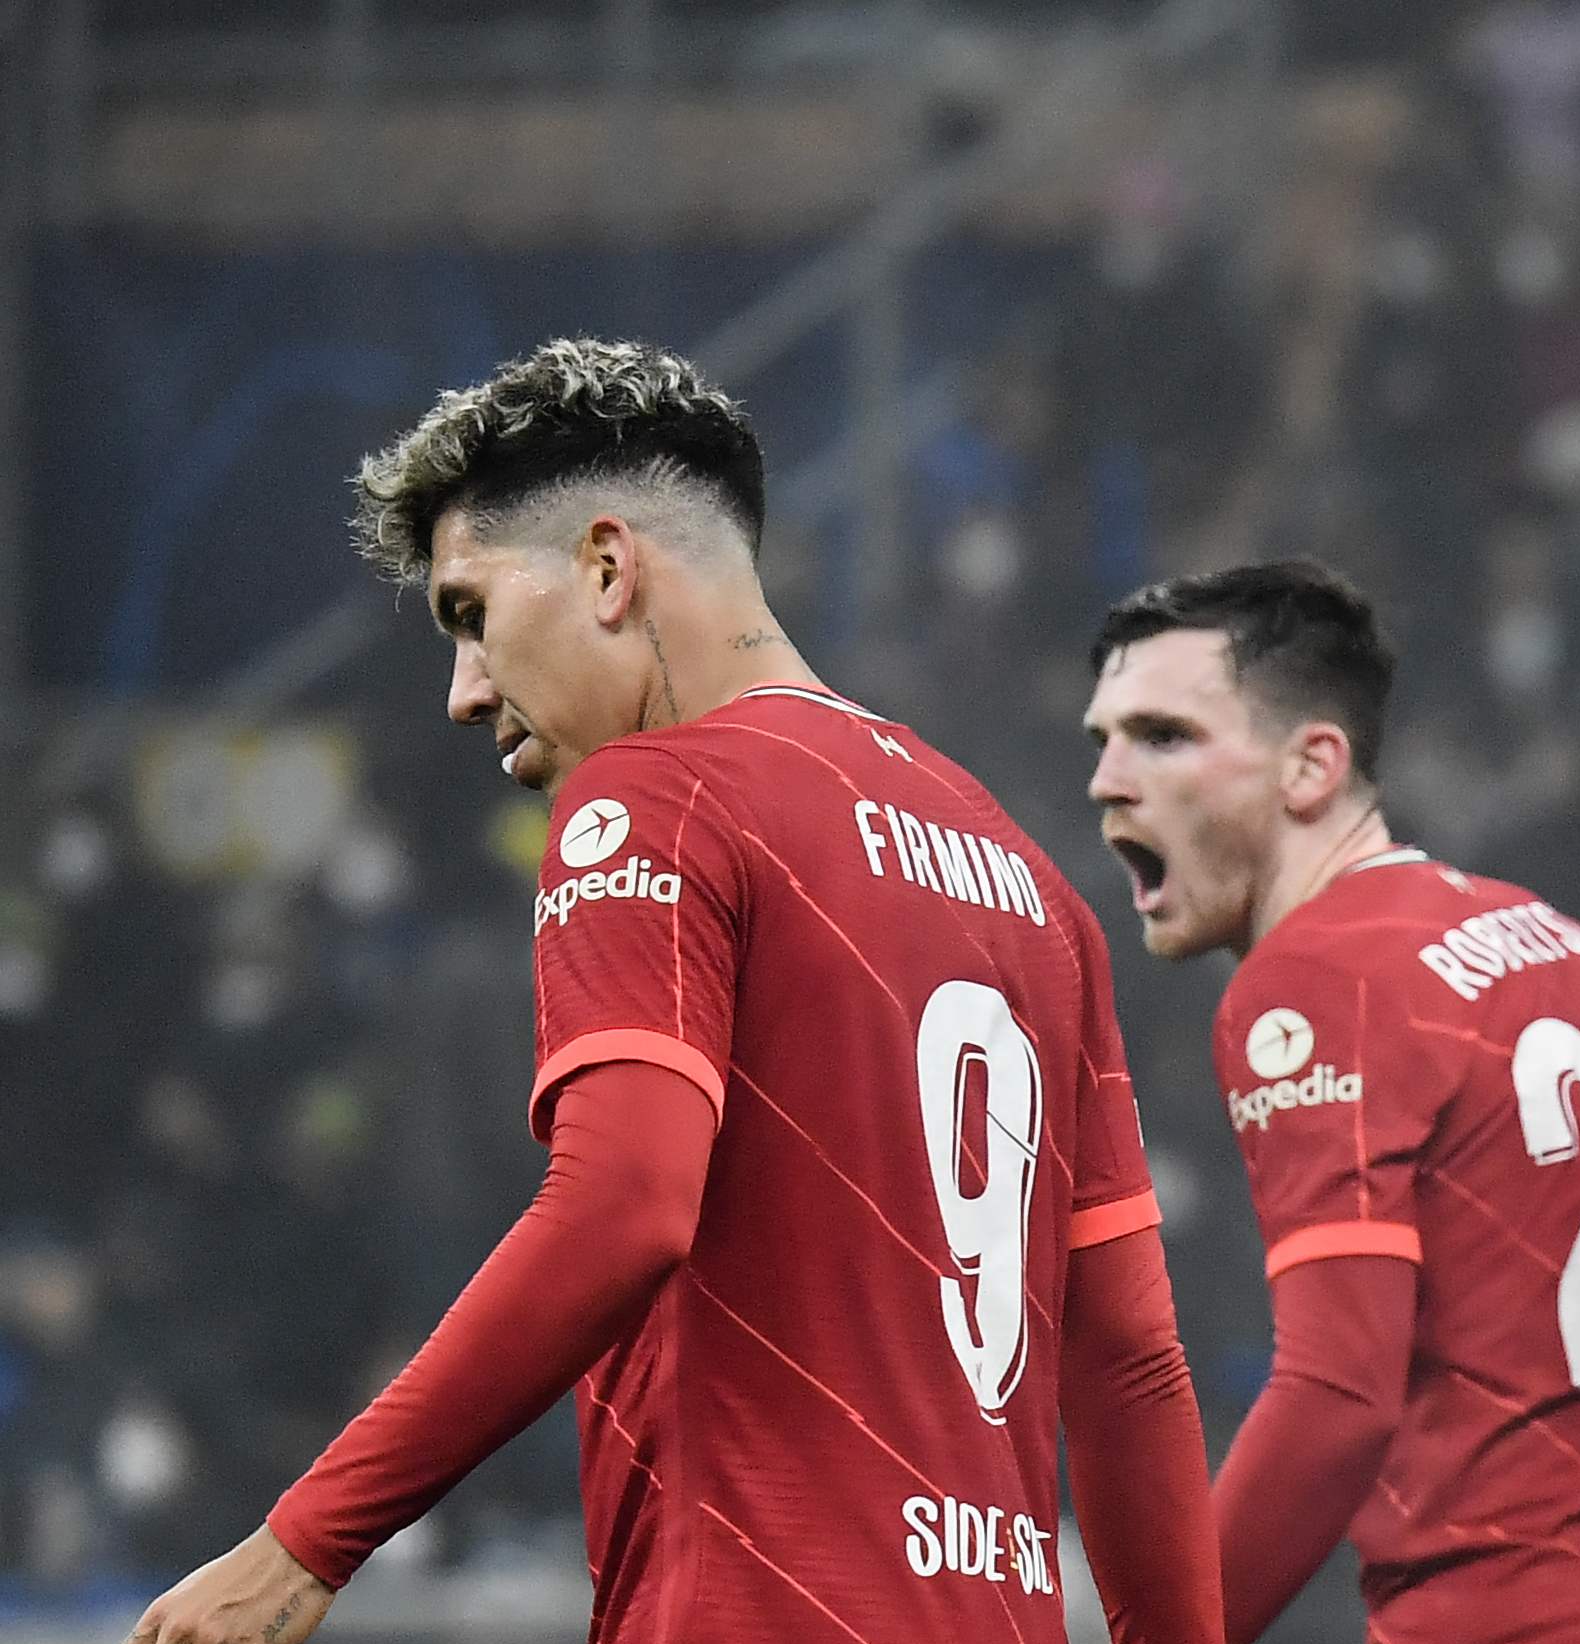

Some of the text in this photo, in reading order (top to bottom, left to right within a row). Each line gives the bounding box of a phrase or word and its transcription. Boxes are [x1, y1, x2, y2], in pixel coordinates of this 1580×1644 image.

[854, 800, 1046, 927] FIRMINO
[916, 980, 1043, 1426] 9
[902, 1496, 1006, 1582] SIDE
